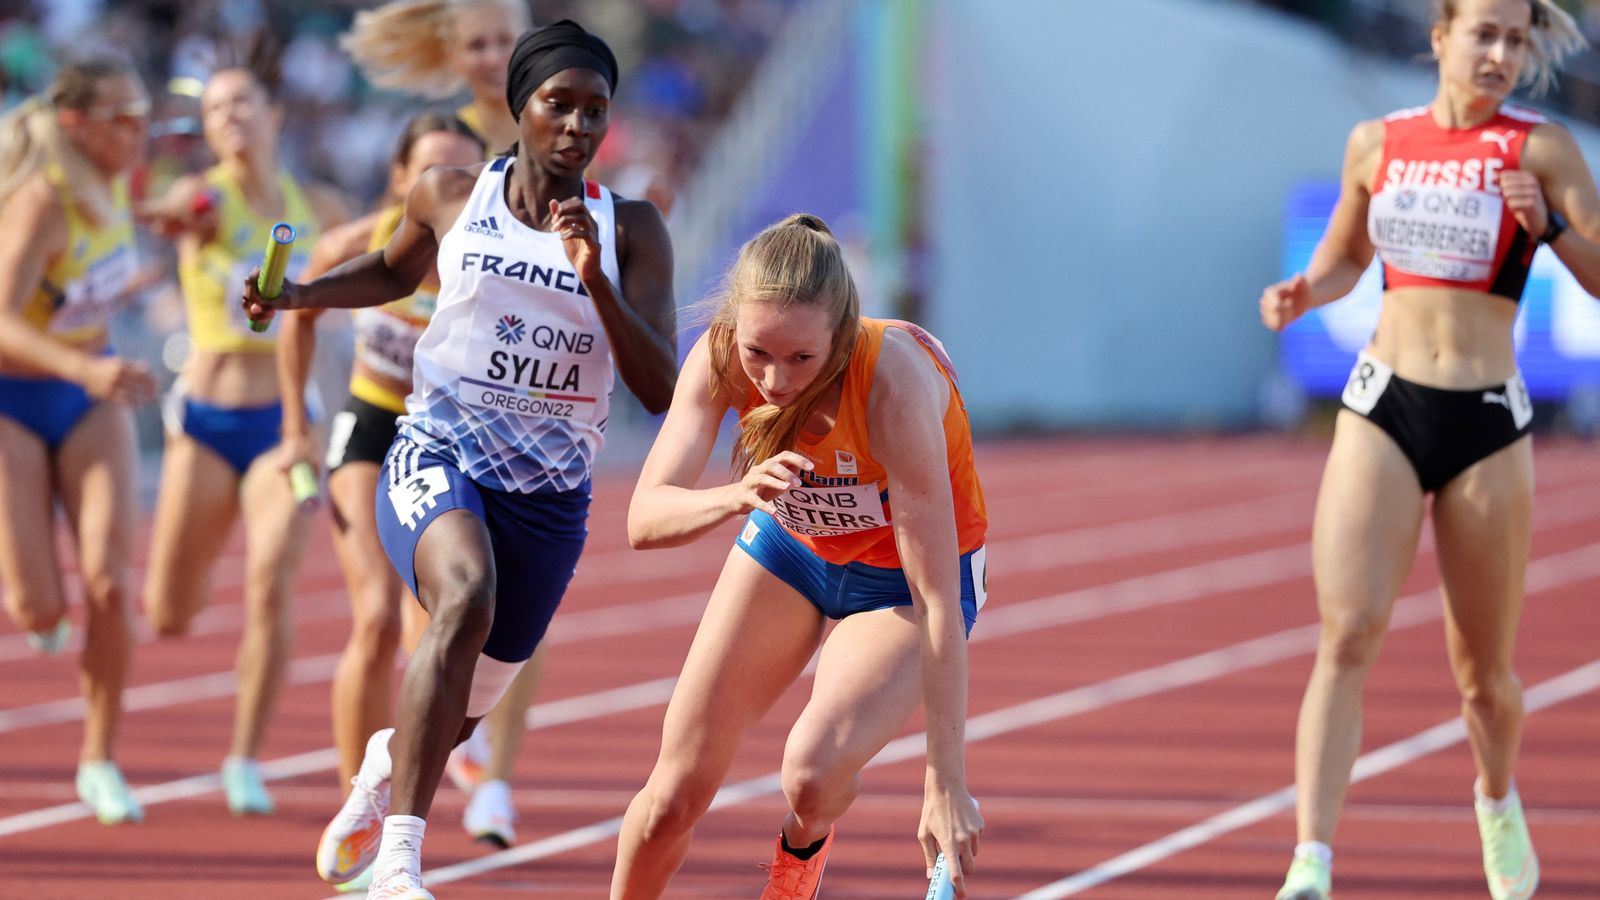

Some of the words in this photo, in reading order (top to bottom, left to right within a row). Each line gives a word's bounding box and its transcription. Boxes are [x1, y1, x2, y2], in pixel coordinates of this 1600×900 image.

[1423, 191, 1481, 218] QNB
[532, 324, 595, 354] QNB
[487, 350, 580, 392] SYLLA
[481, 391, 574, 418] OREGON22
[406, 477, 431, 504] 3
[789, 488, 858, 508] QNB
[773, 497, 881, 528] EETERS
